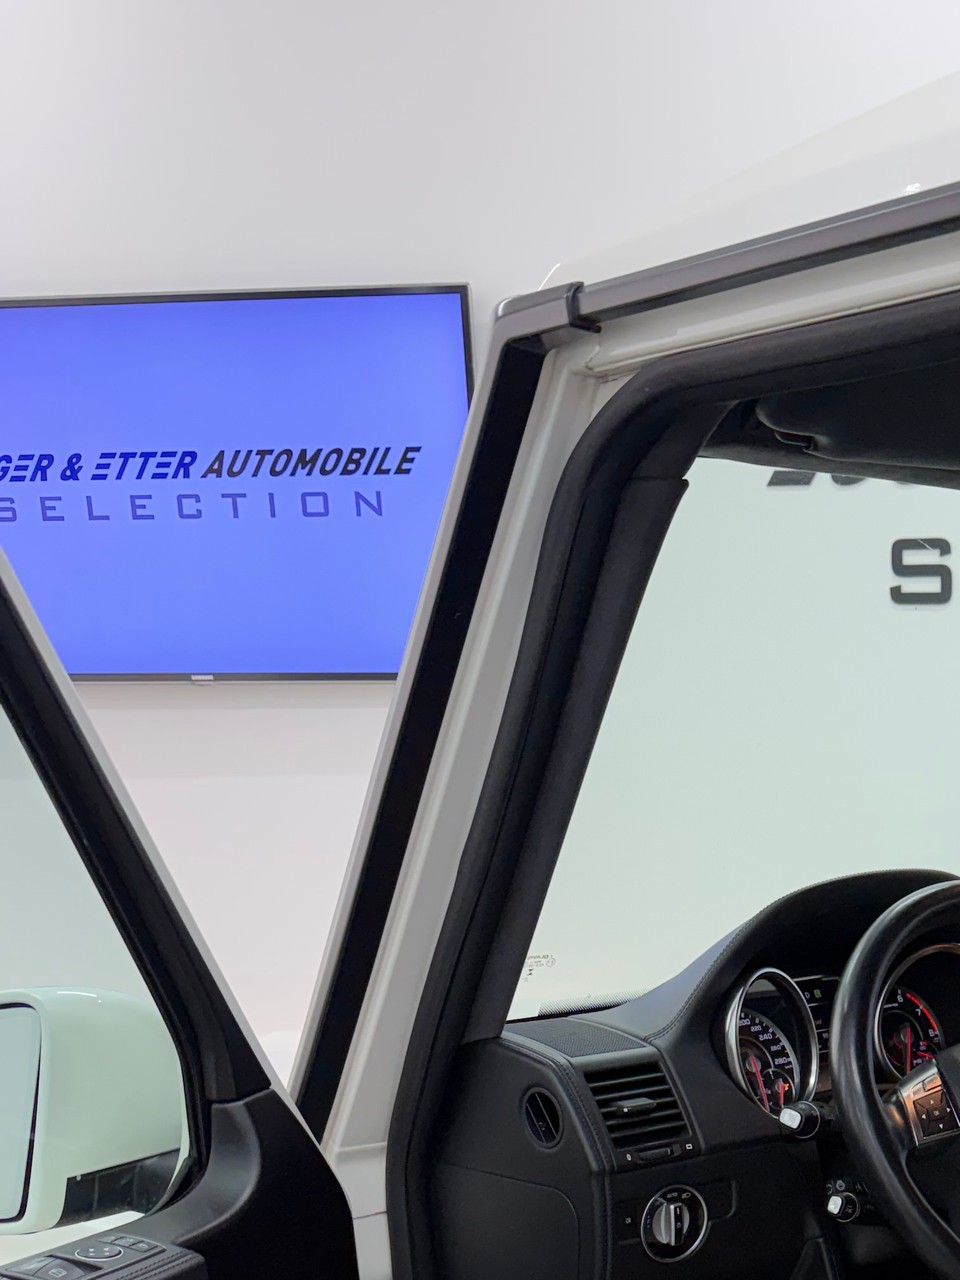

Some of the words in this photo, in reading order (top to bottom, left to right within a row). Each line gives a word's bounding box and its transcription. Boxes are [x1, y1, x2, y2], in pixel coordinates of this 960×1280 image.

[60, 453, 83, 481] &
[90, 451, 198, 480] ETTER
[200, 446, 422, 479] AUTOMOBILE
[0, 490, 383, 523] SELECTION
